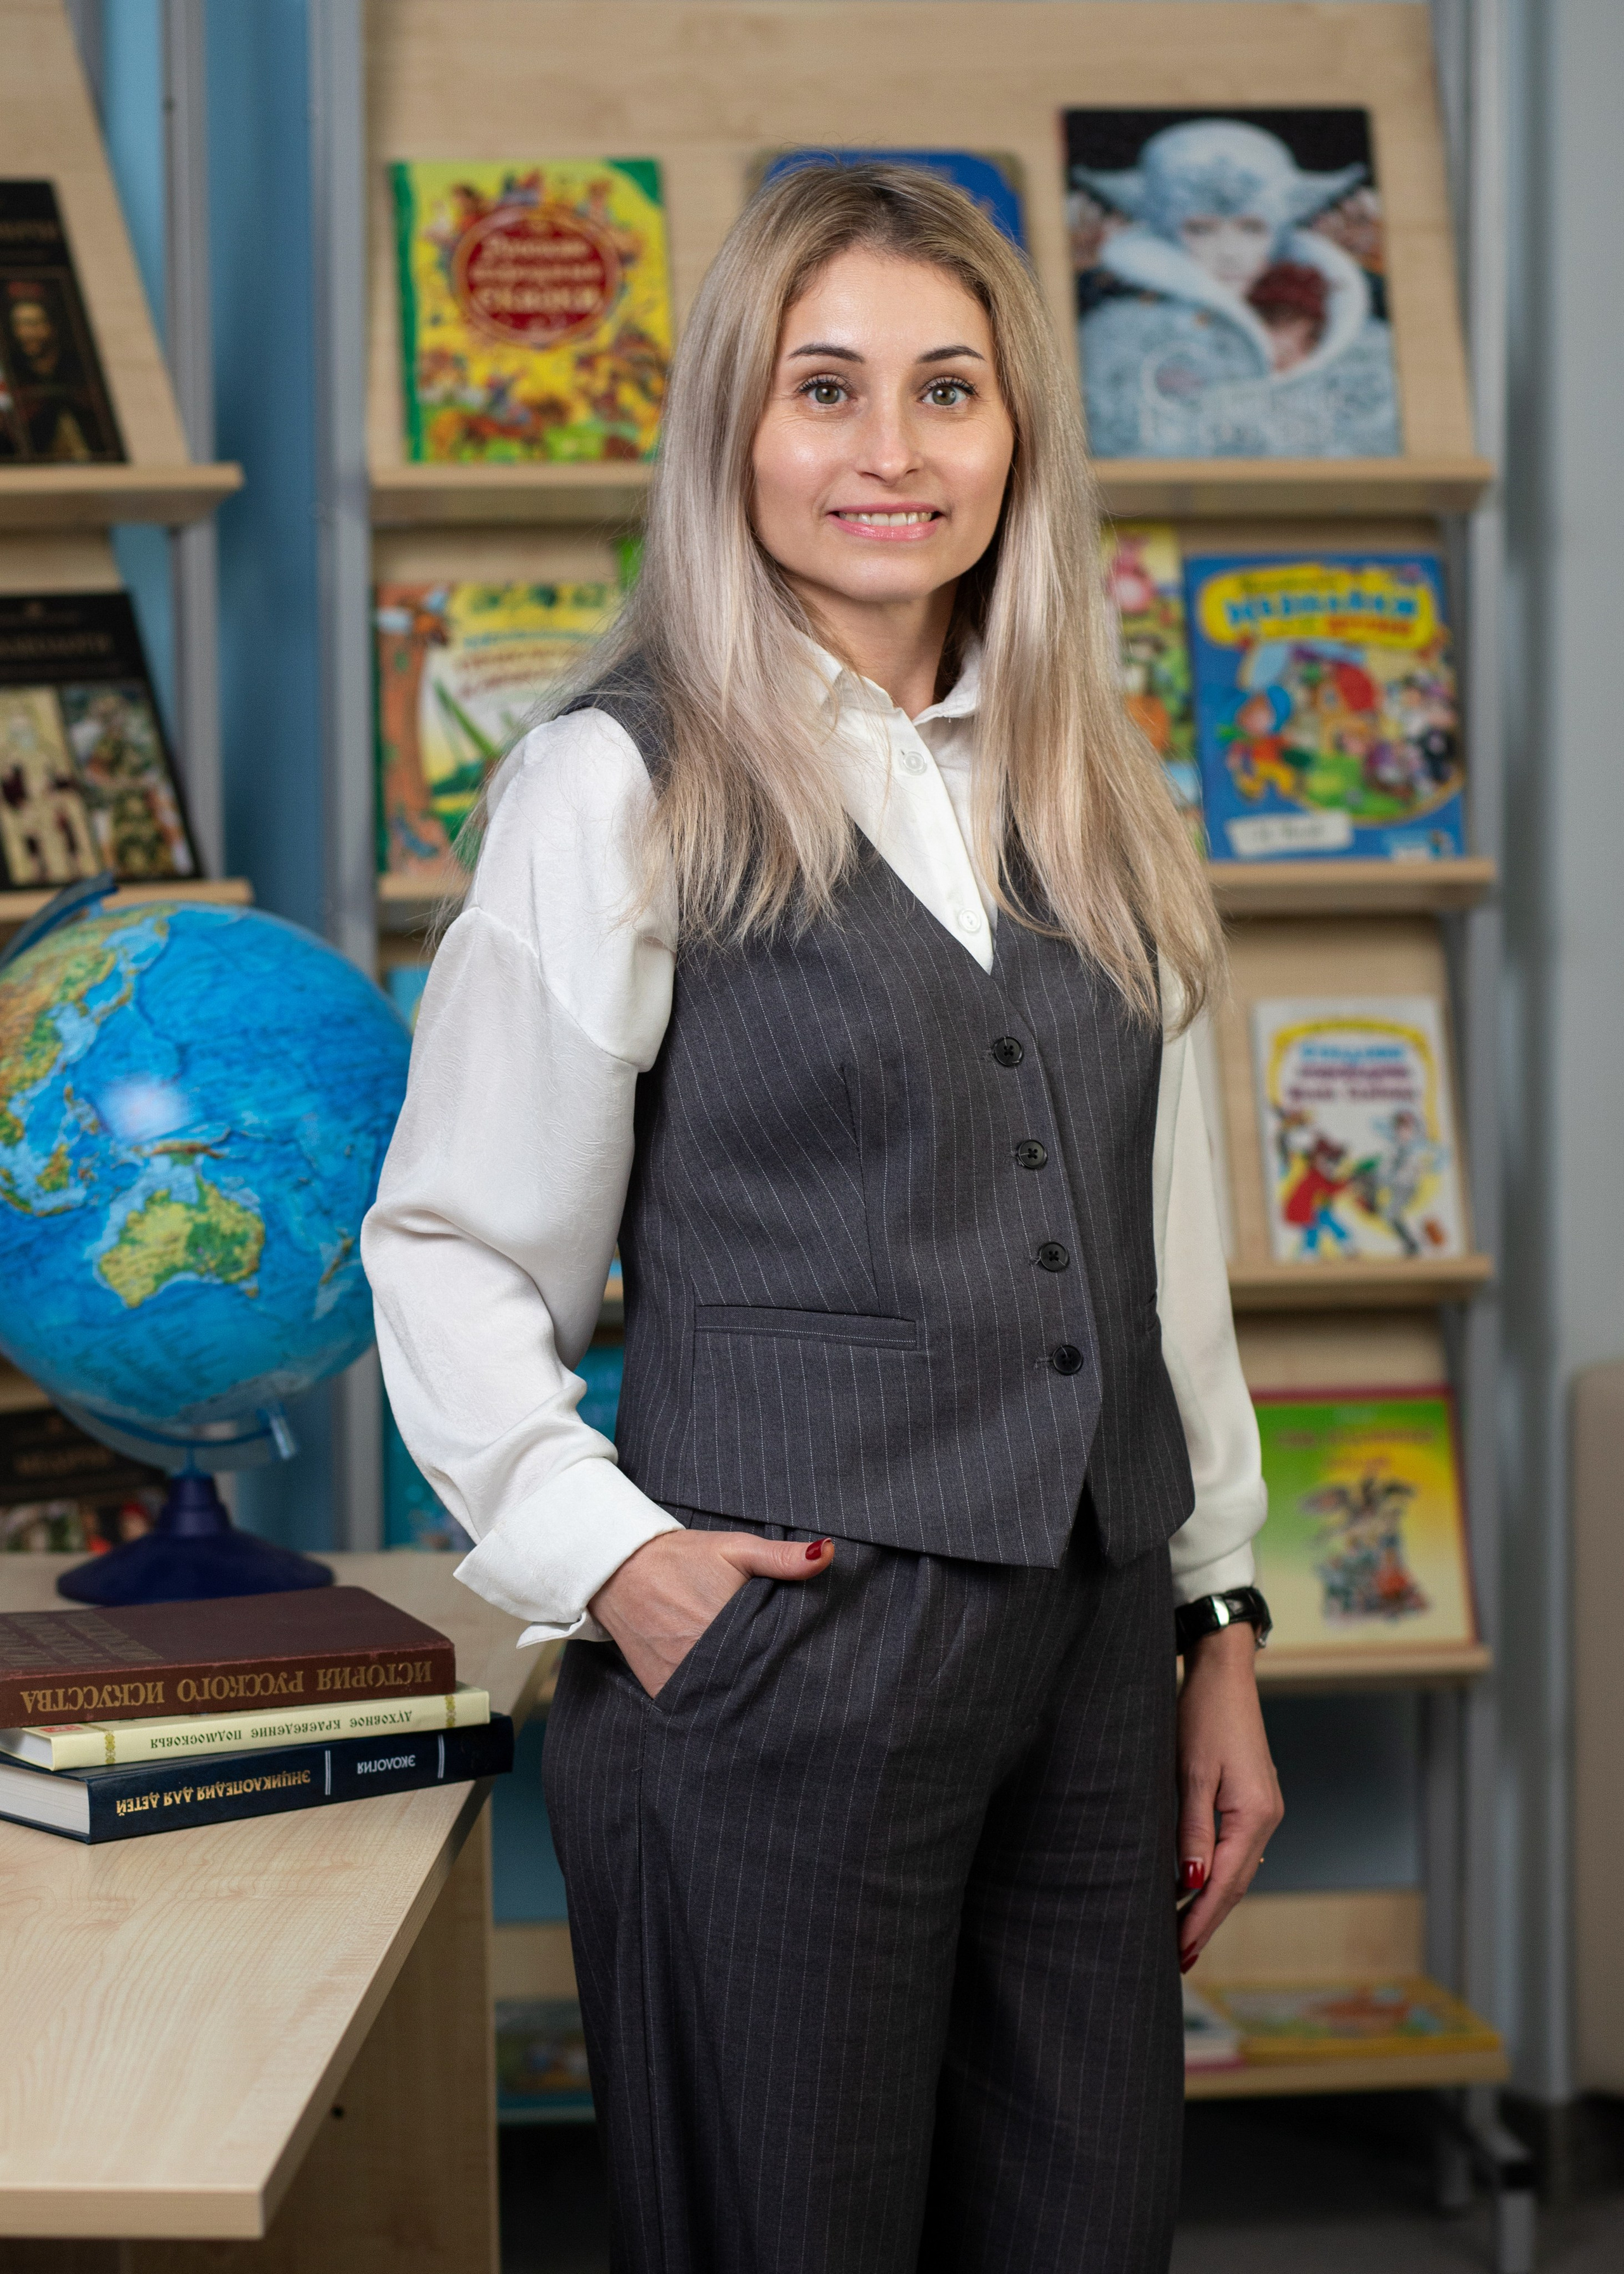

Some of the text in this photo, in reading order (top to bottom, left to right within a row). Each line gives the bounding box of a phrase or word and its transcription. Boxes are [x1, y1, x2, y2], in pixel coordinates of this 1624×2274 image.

[20, 1661, 432, 1713] ИСТОРИЯ РУССКОГО ИСКУССТВА
[150, 1711, 412, 1749] ДУХОВНОЕ КРАЕВЕДЕНИЕ ПОДМОСКОВЬЯ
[357, 1754, 416, 1775] ЭКОЛОГИЯ
[115, 1770, 311, 1816] ЭНЦИКЛОПЕДИЯ ДЛЯ ДЕТЕЙ
